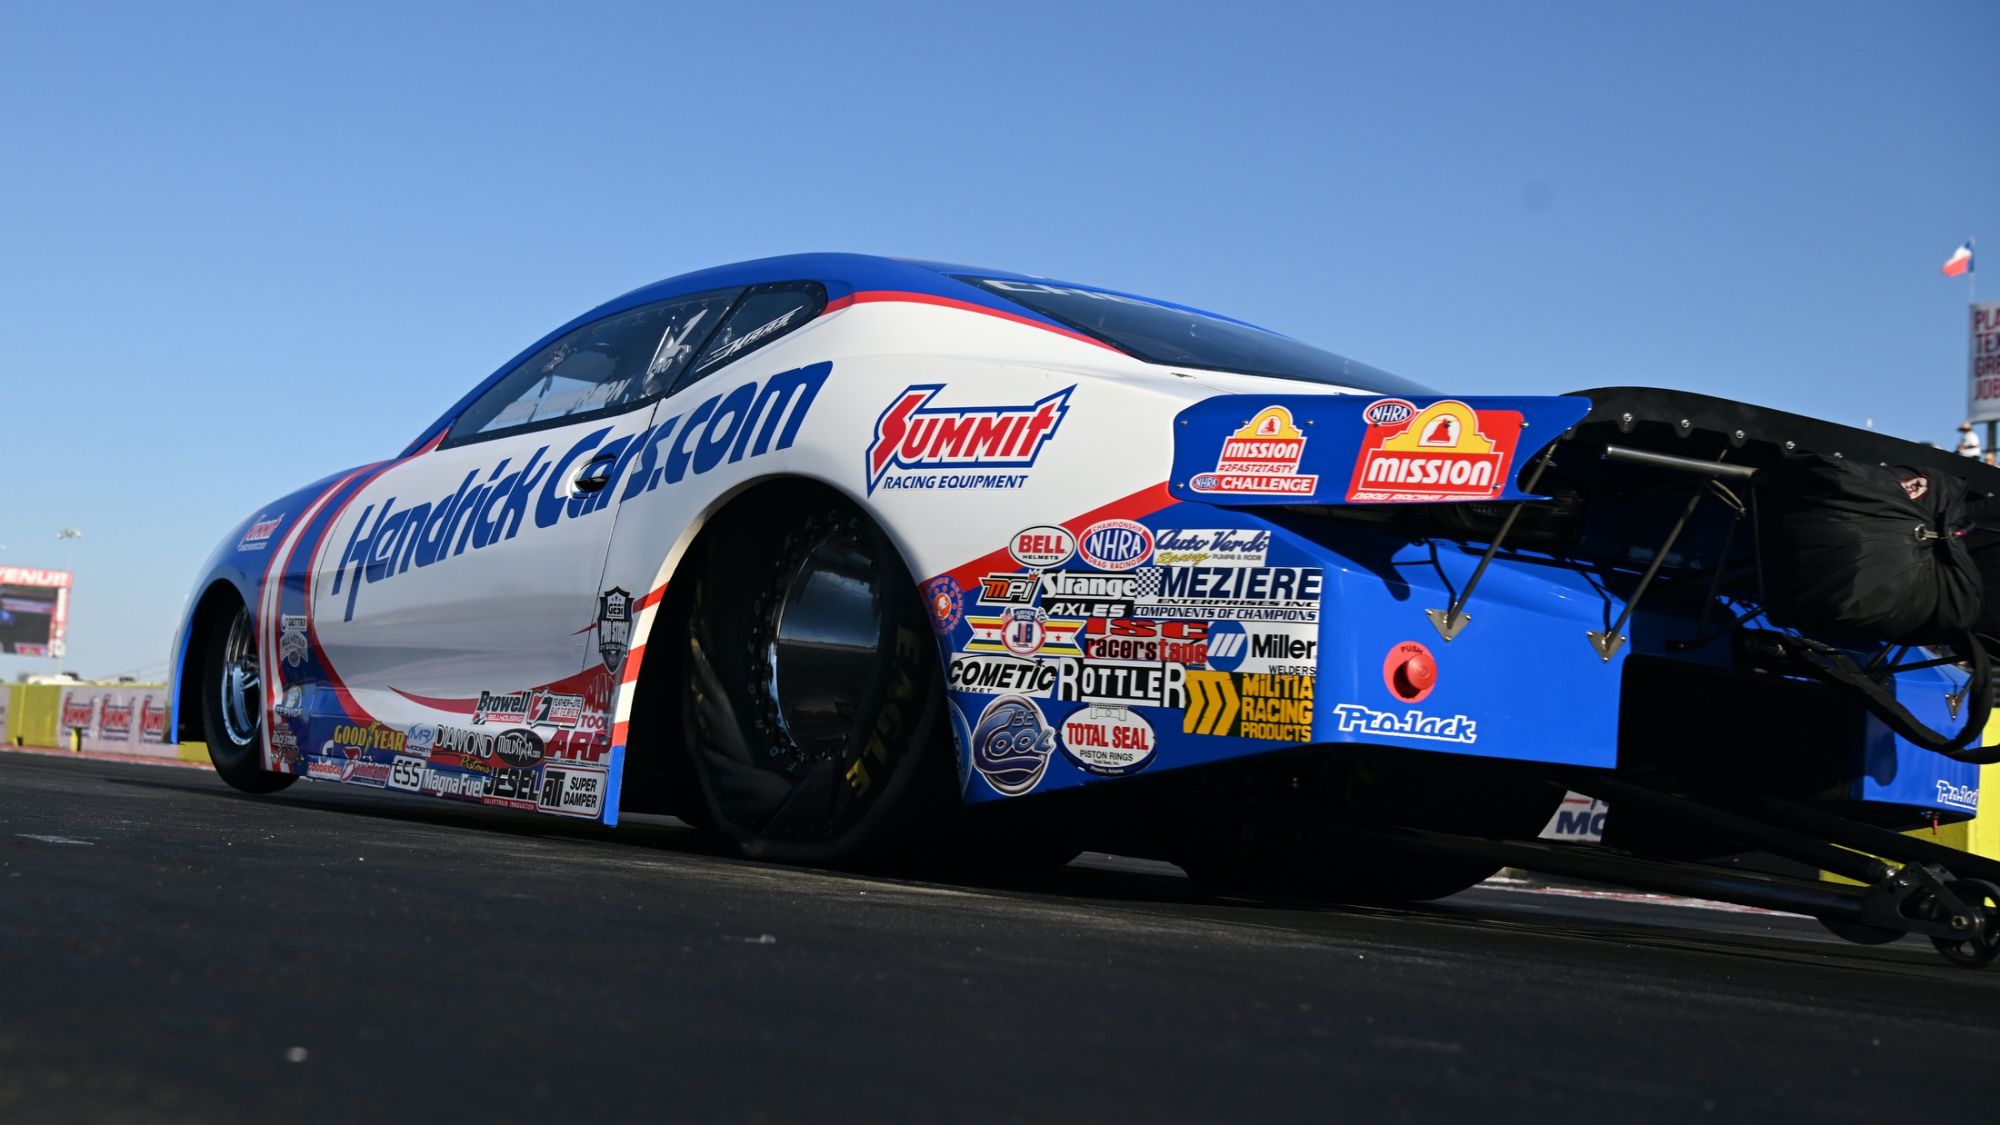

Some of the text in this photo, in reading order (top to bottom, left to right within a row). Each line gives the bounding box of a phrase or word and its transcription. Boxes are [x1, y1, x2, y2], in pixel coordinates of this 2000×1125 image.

[1371, 405, 1410, 422] NHRA
[1225, 442, 1300, 459] MISSION
[1218, 463, 1296, 474] #2FAST2TASTY
[1367, 457, 1493, 486] MISSION
[883, 474, 1029, 490] RACING EQUIPMENT
[1195, 475, 1312, 492] NHRA CHALLENGE
[1352, 491, 1390, 501] DRAG
[1391, 493, 1446, 501] RACING
[1091, 521, 1143, 532] CHAMPIONSHIP
[1018, 535, 1065, 554] BELL
[1090, 528, 1141, 561] NHRA
[1155, 530, 1270, 553] Auto Verdi
[1087, 556, 1107, 569] DRAG
[1041, 568, 1137, 600] Strange
[1158, 567, 1323, 600] MEZIERE
[1047, 602, 1126, 617] AXLES
[1156, 598, 1281, 607] ENTERPRISES
[1134, 606, 1317, 621] COMPONENTS OF CHAMPIONS
[1086, 618, 1208, 639] ISC
[1251, 634, 1317, 660] Miller
[1401, 645, 1423, 655] PUSH
[949, 659, 1057, 691] COMETIC
[1268, 664, 1317, 676] WELDERS
[952, 686, 993, 694] GASKET
[1057, 656, 1186, 709] ROTTLER
[477, 690, 531, 713] Browell
[1241, 699, 1314, 723] RACING
[1012, 710, 1037, 727] BE
[1333, 703, 1477, 744] Pro-Jack
[435, 724, 494, 758] DIAMOND
[1066, 722, 1149, 750] TOTAL SEAL
[1240, 721, 1312, 742] PRODUCTS
[543, 730, 613, 761] ARP
[460, 754, 491, 773] Pistons
[1079, 749, 1134, 762] PISTON RINGS
[394, 759, 422, 788] ESS
[422, 768, 486, 797] MagnaFuel
[482, 767, 540, 801] JESEL
[569, 776, 598, 793] SUPER
[563, 791, 598, 809] DAMPER
